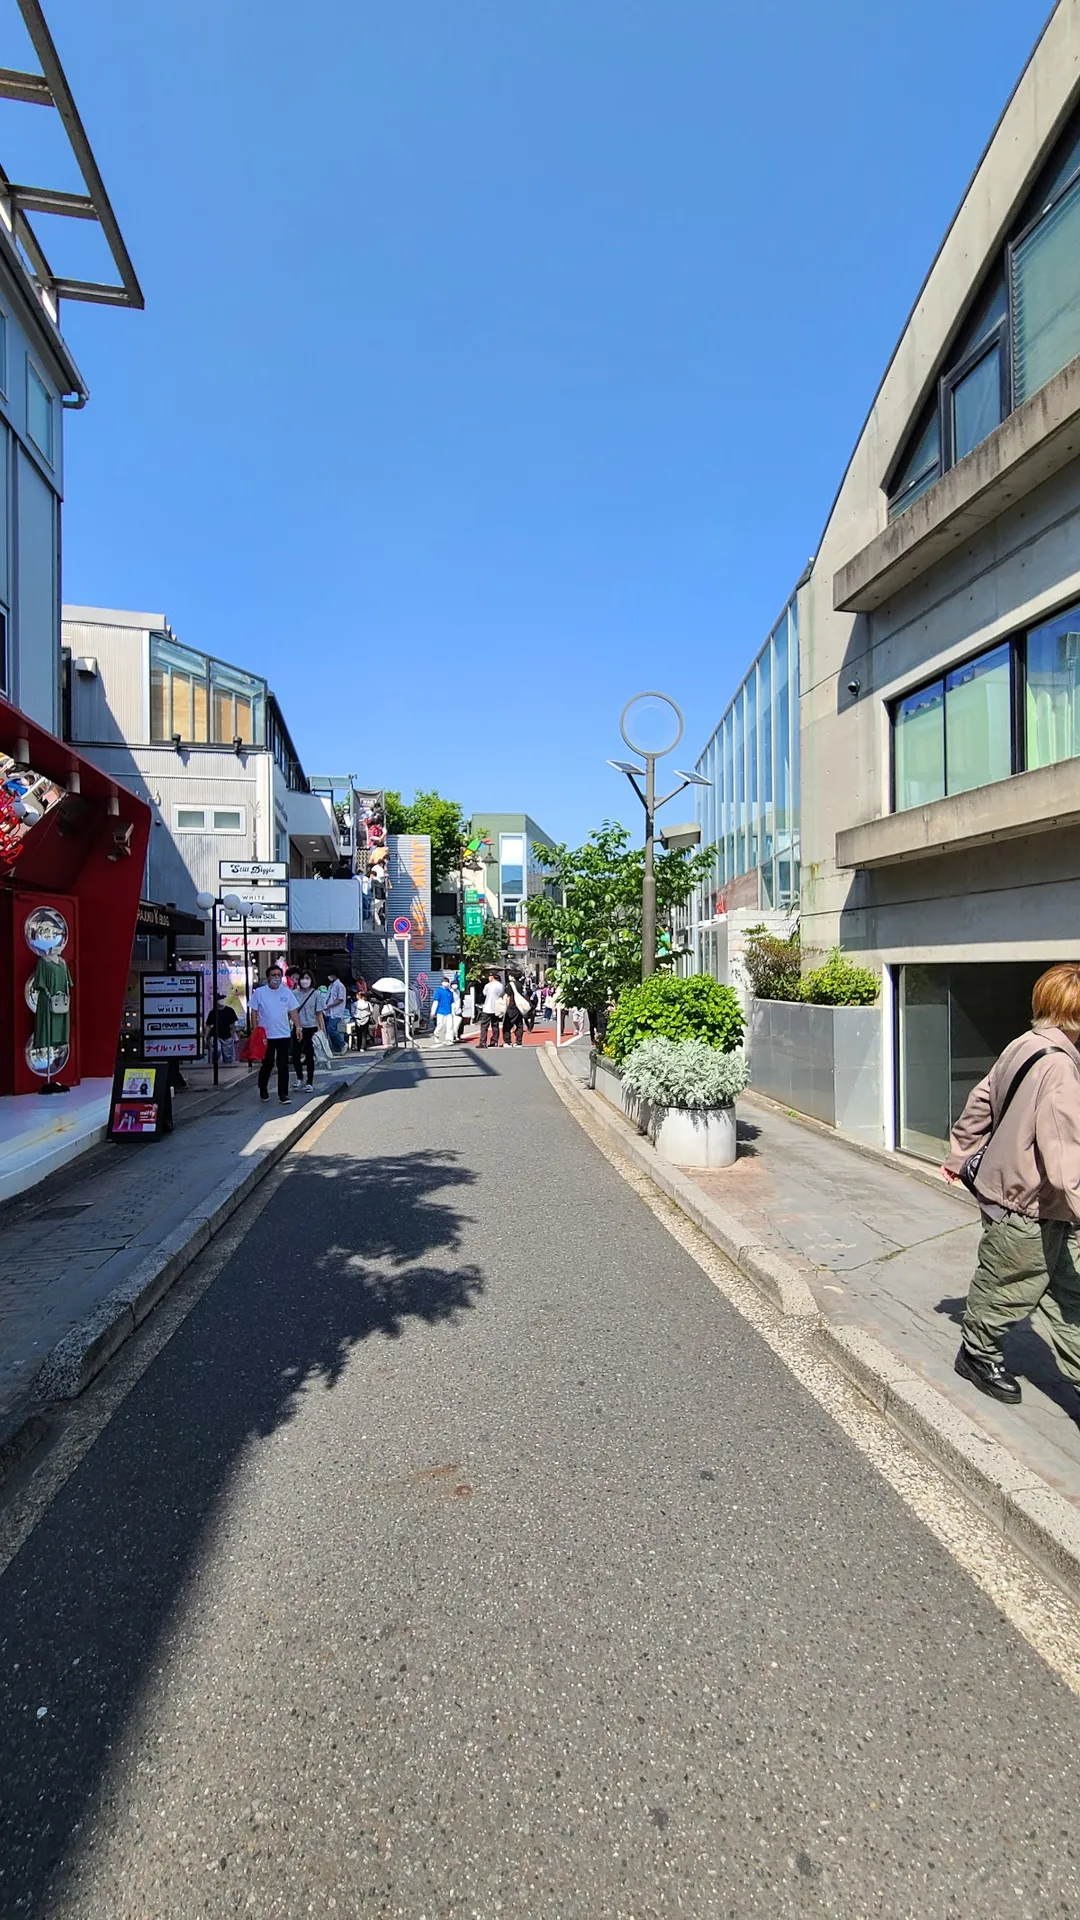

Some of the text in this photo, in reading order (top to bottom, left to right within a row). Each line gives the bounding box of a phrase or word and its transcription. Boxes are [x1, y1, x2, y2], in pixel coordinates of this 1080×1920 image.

[230, 864, 250, 874] Still
[412, 840, 426, 889] JUNK
[139, 1109, 156, 1117] miffy
